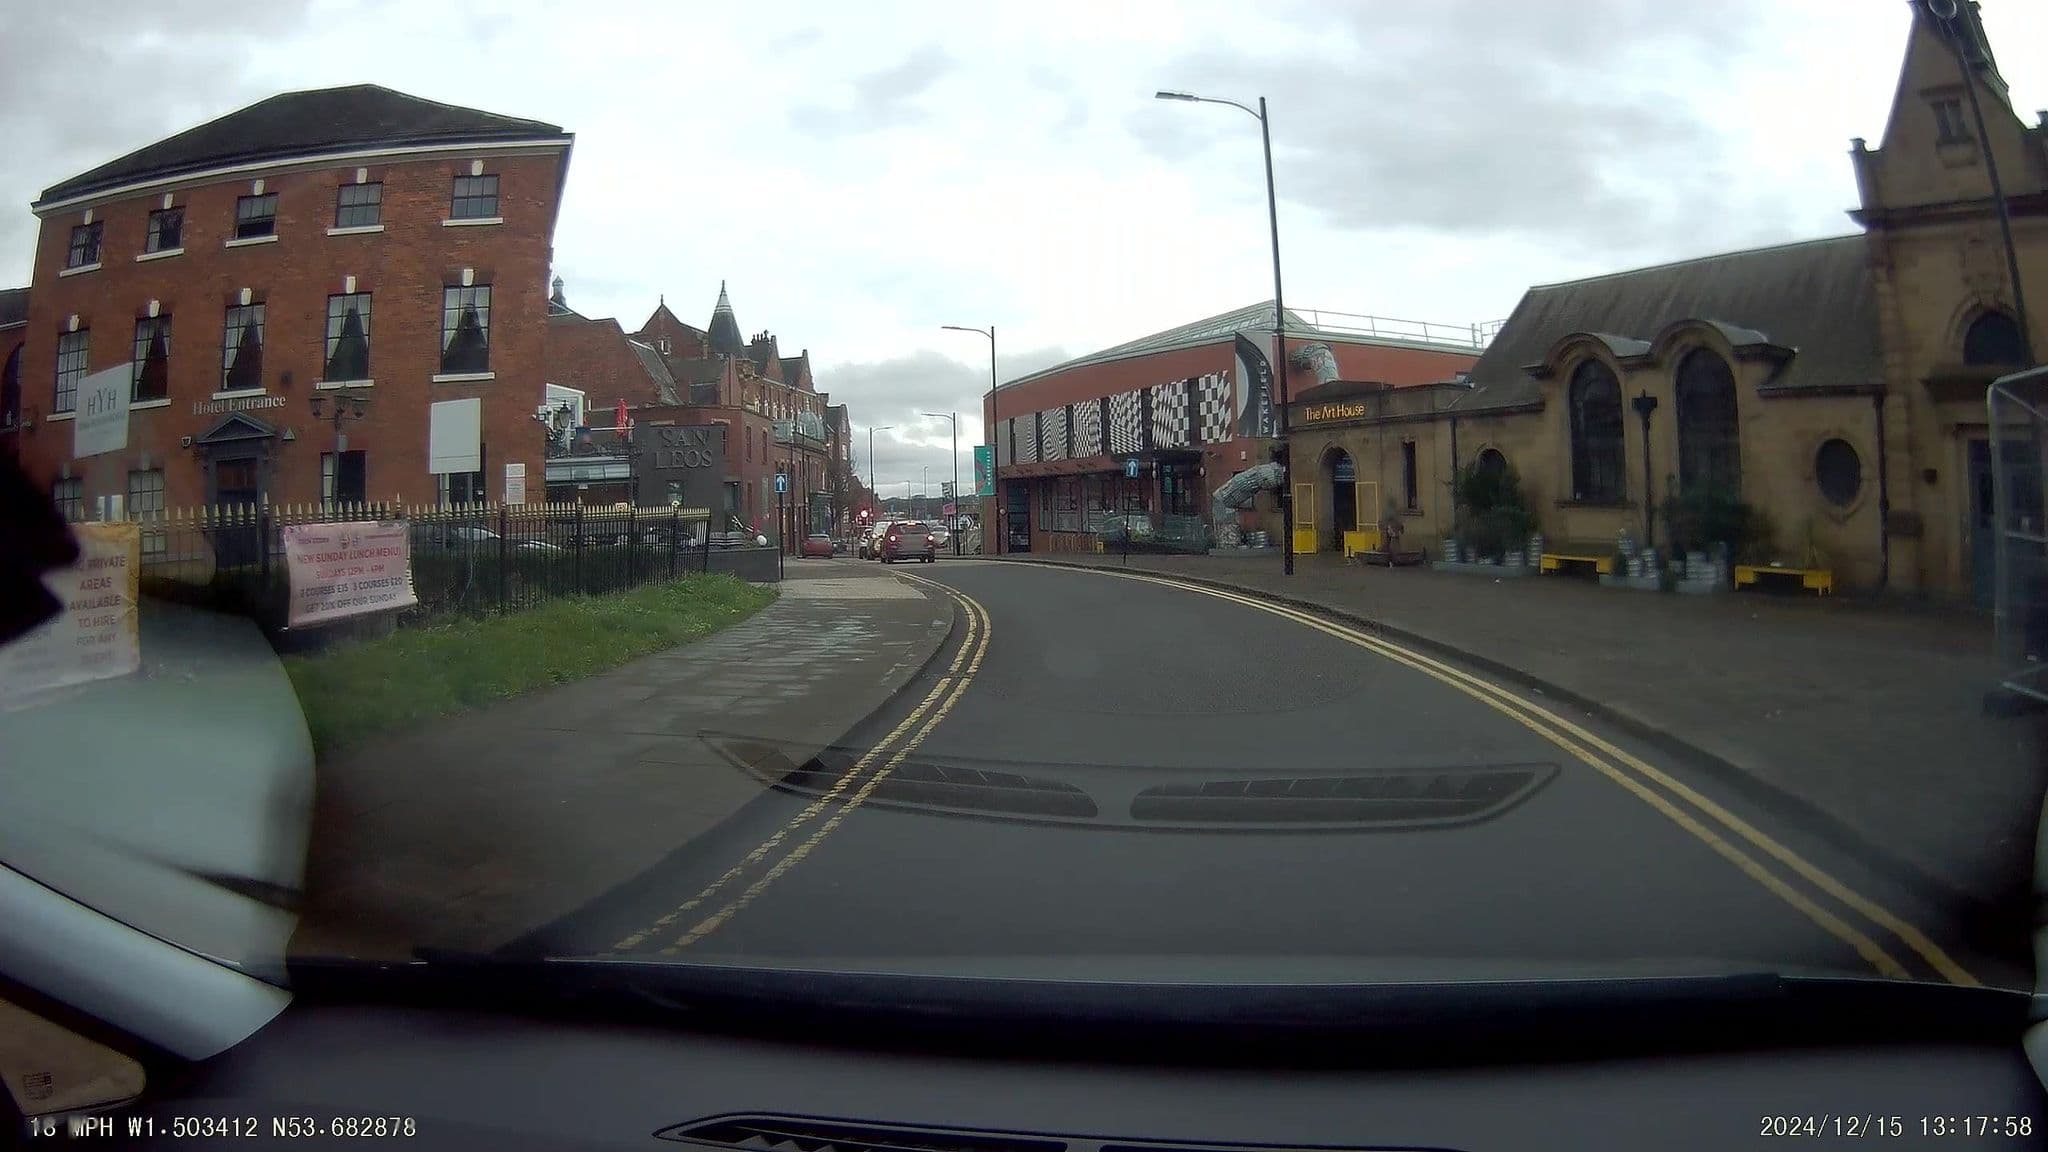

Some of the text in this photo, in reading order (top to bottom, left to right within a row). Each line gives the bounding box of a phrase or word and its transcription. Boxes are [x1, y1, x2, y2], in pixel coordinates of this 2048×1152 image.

[87, 387, 117, 416] HYH
[1259, 360, 1270, 434] WAKEFIELD
[193, 397, 286, 415] Hotel Entrance
[1305, 403, 1365, 421] The Art House
[661, 428, 711, 447] SAN
[656, 449, 713, 469] LEOS
[297, 552, 315, 564] NEW
[316, 550, 347, 562] SUNDAY
[349, 547, 374, 560] LUNCH
[315, 567, 346, 579] SAYS
[80, 577, 112, 591] AREAS
[359, 578, 390, 590] COURSES
[70, 595, 121, 610] AVAILABLE
[337, 598, 351, 609] OFF
[353, 596, 369, 607] OUR
[370, 593, 397, 605] SUNDAY
[78, 615, 117, 628] TO HIRE
